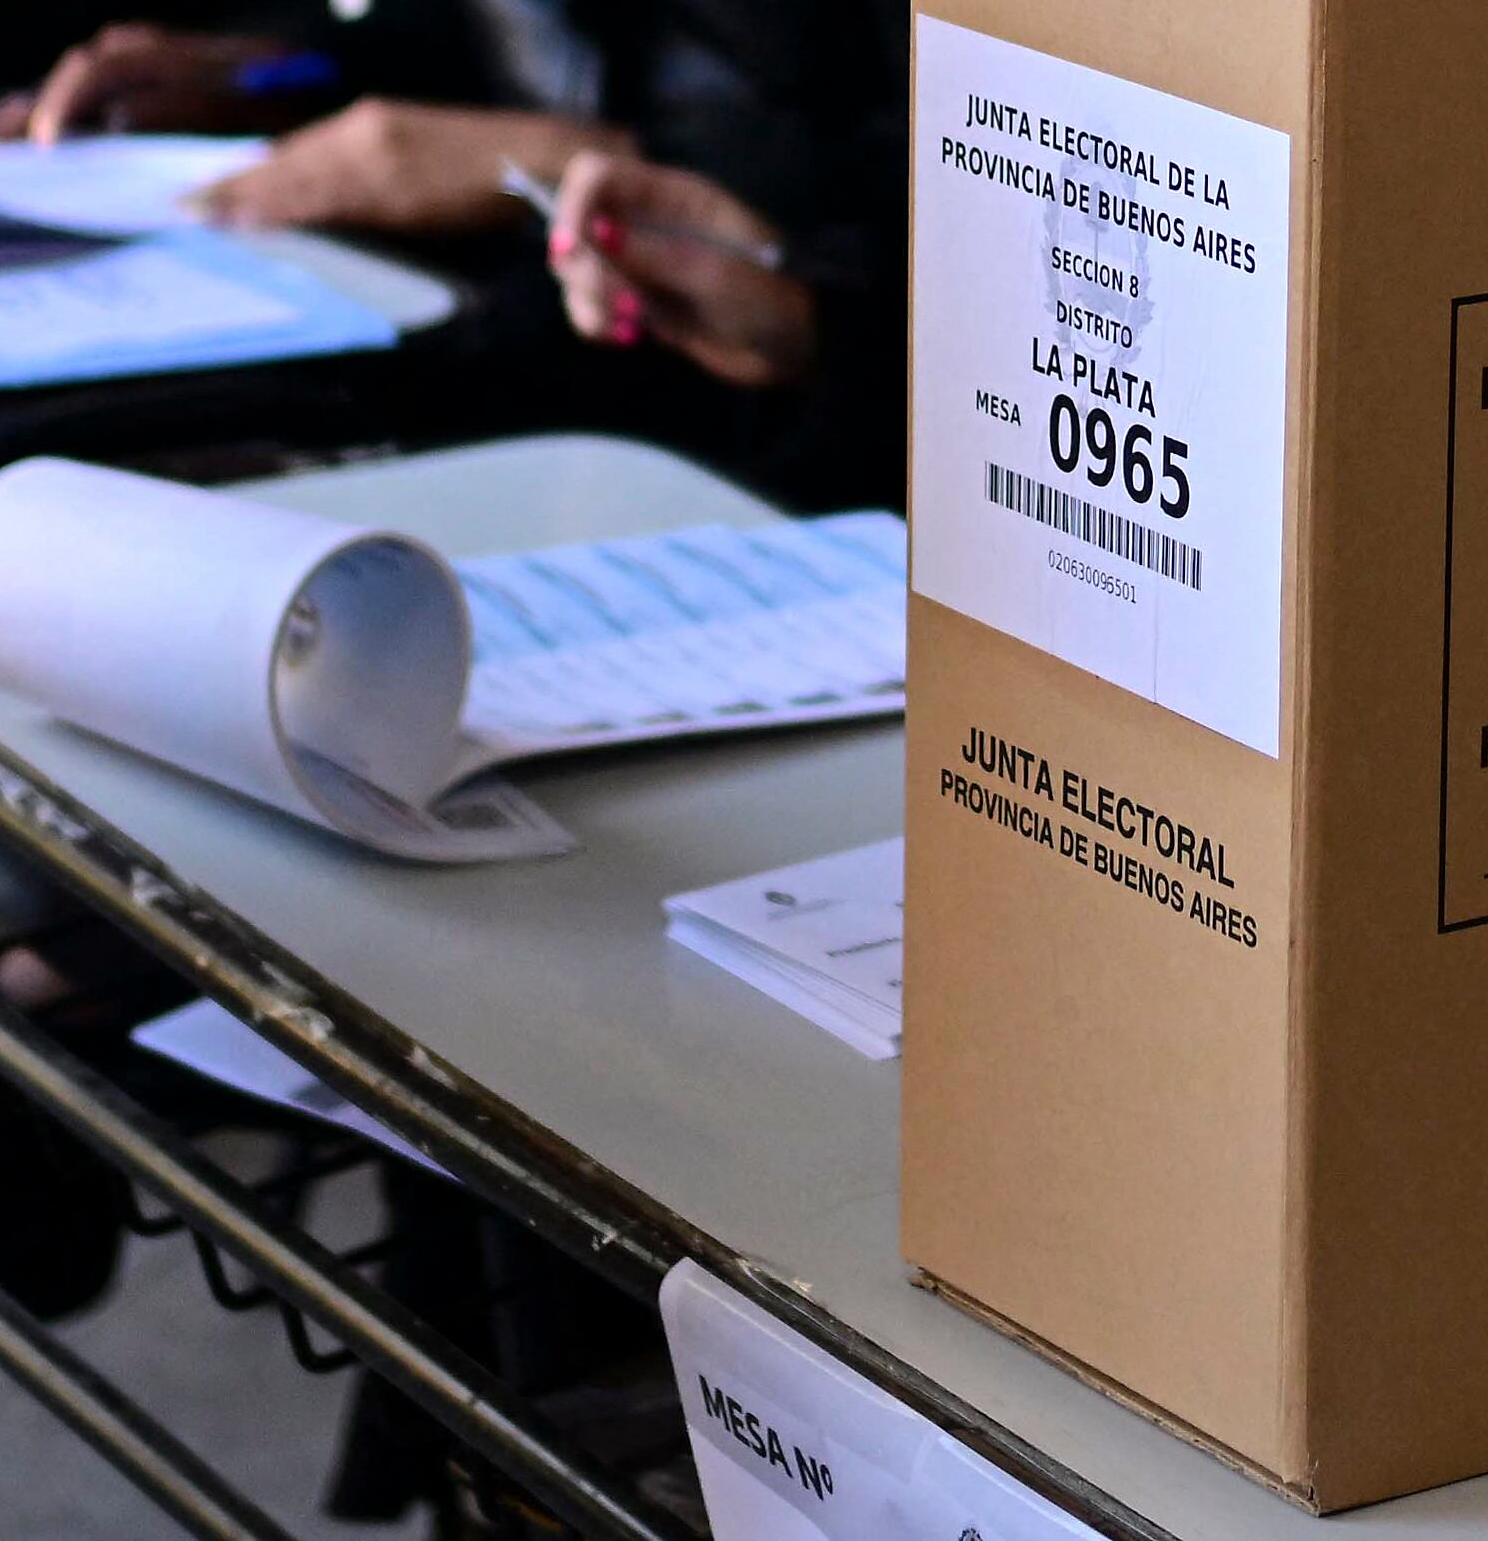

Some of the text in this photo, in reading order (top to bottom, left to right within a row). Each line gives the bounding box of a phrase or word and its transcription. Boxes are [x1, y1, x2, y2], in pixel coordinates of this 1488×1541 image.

[942, 137, 1256, 275] PROVINCIA DE BUENOS AIRES
[967, 94, 1230, 210] JUNTA ELECTORAL DE LA
[1051, 247, 1139, 298] SECCION 8
[1056, 300, 1133, 348] DISTRITO
[1033, 338, 1156, 417] LA PLATA
[976, 390, 1190, 519] MESA 0965
[1049, 550, 1136, 604] 020630096501
[942, 769, 1257, 948] PROVINCIA DE BUENOS AIRES
[962, 728, 1234, 888] JUNTA ELECTORAL
[698, 1375, 792, 1478] MESA
